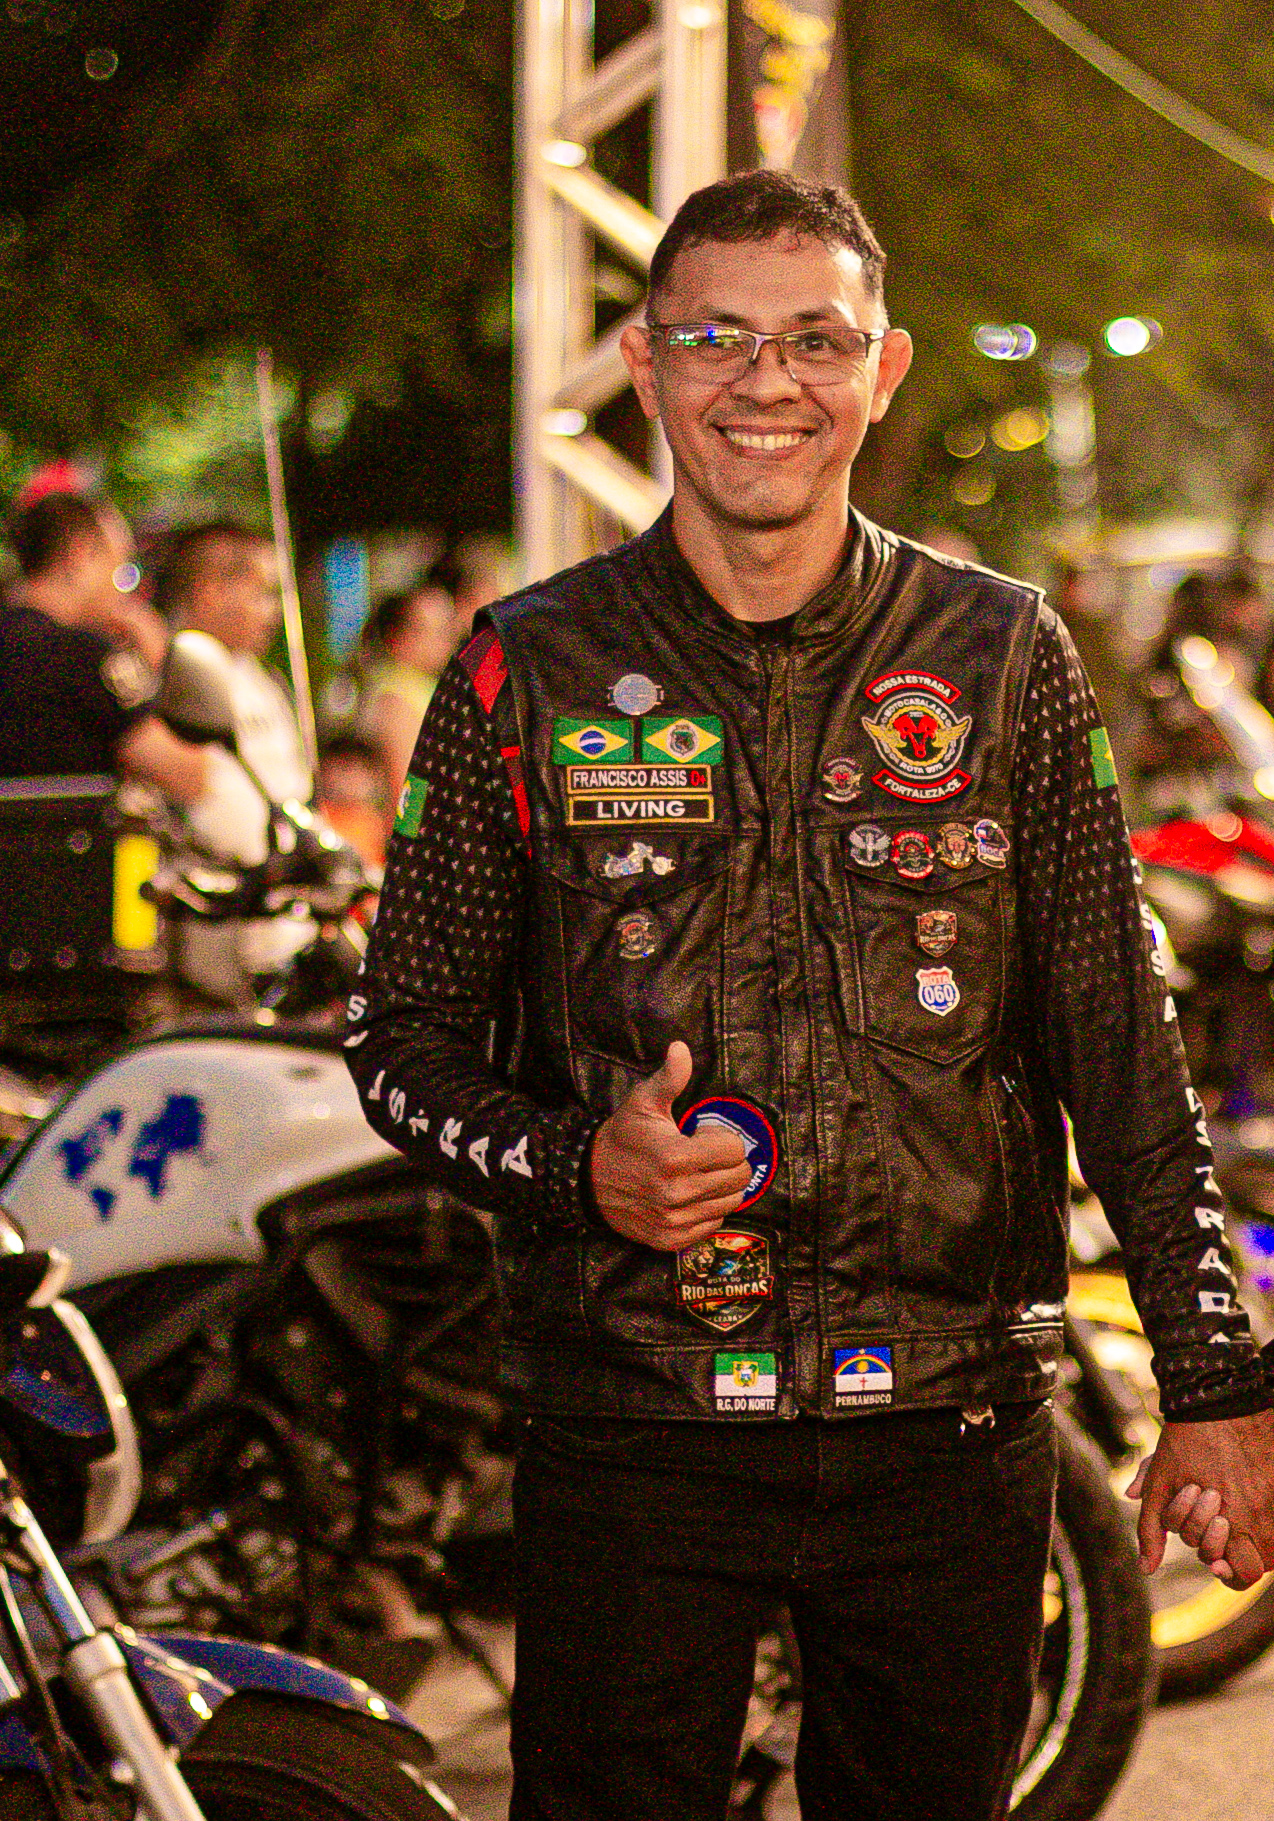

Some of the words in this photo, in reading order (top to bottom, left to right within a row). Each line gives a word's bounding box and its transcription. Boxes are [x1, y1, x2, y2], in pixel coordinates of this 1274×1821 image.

[872, 676, 905, 696] NOSSA
[904, 675, 951, 697] ESTRADA
[573, 770, 648, 788] FRANCISCO
[650, 770, 688, 787] ASSIS
[884, 778, 962, 799] FORTALEZA-CE
[597, 800, 686, 819] LIVING
[921, 974, 953, 986] ROTA
[923, 984, 954, 1005] 060
[682, 1284, 705, 1300] RIO
[706, 1287, 724, 1297] DAS
[734, 1398, 747, 1411] DO
[748, 1398, 776, 1411] NORTE
[835, 1393, 892, 1407] PERNAMBUCO
